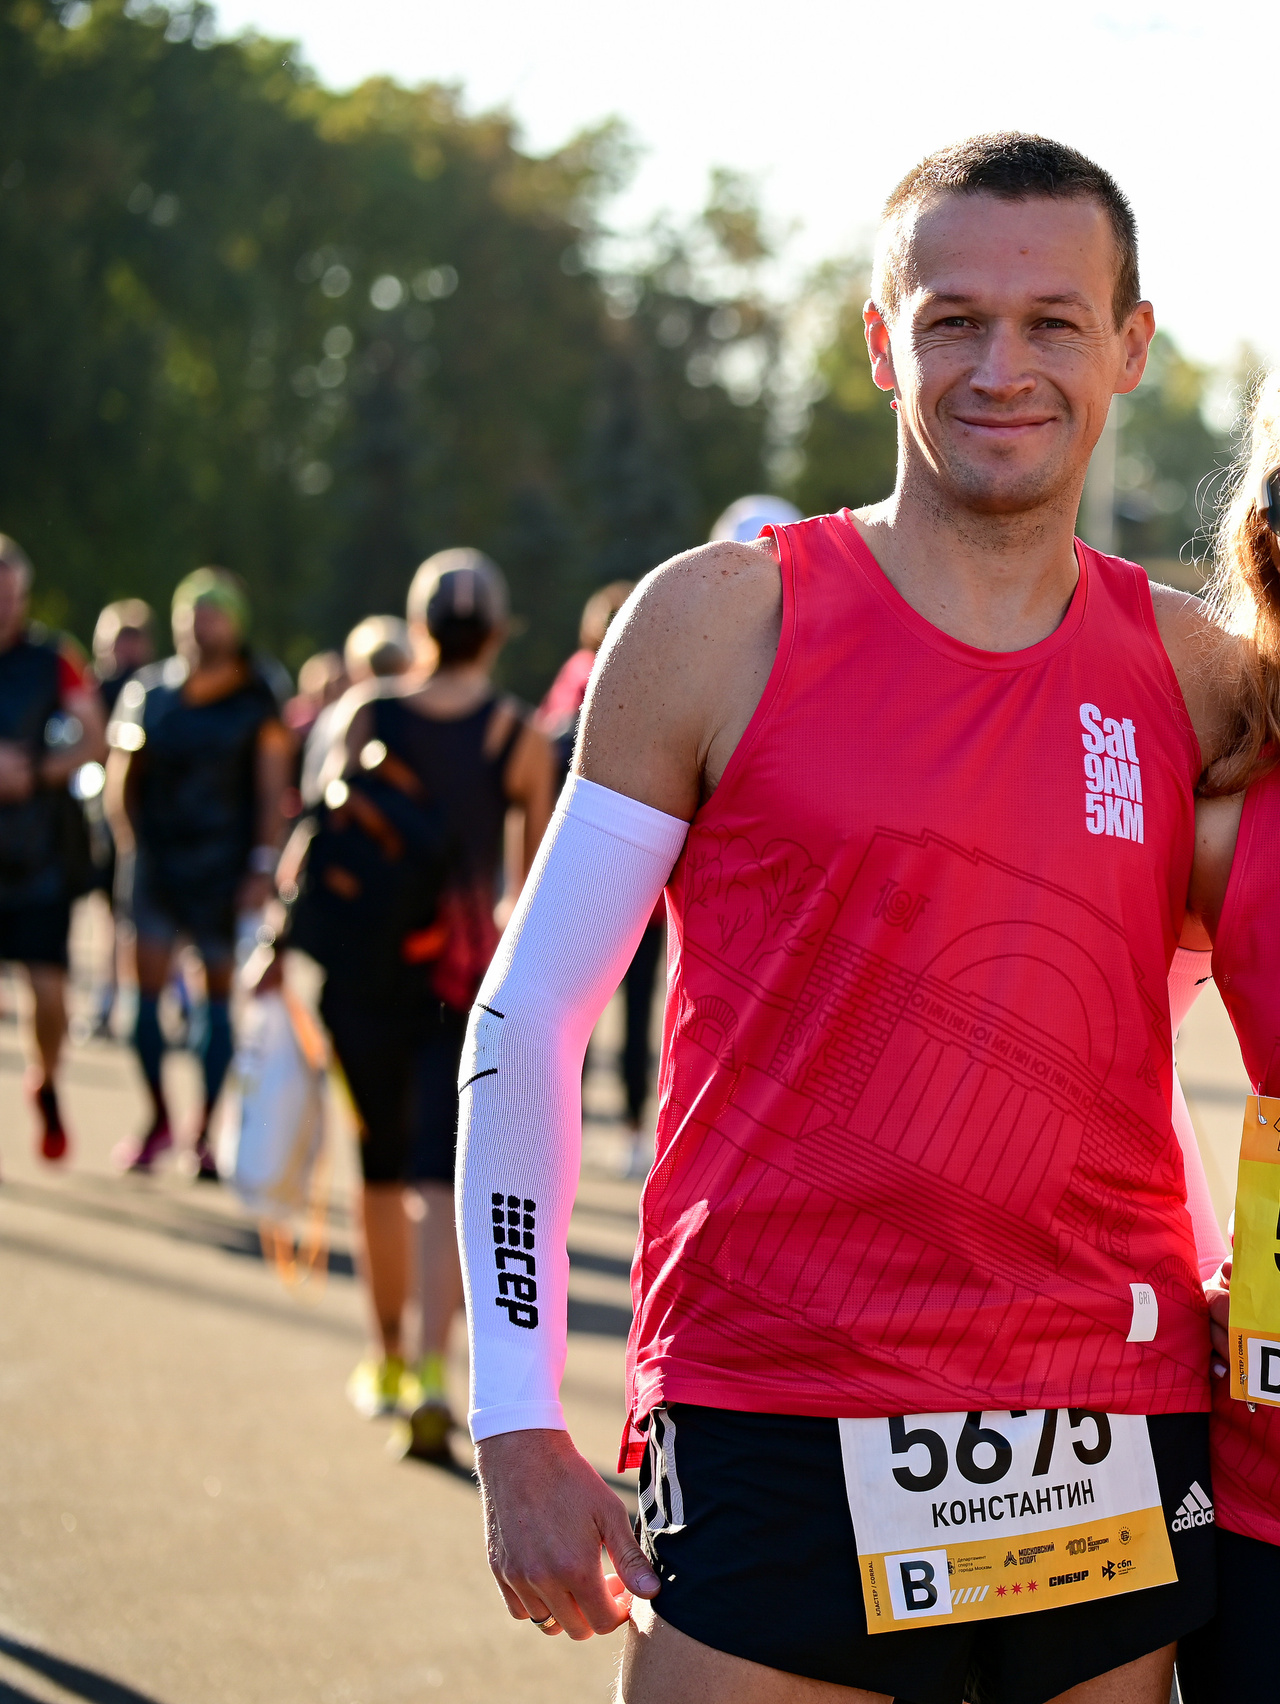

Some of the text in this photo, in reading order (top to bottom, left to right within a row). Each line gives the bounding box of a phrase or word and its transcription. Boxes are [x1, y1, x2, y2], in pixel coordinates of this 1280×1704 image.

[1079, 702, 1140, 764] Sat
[1084, 753, 1143, 804] 9AM
[1085, 793, 1144, 844] 5KM
[494, 1247, 539, 1330] cep
[888, 1408, 1112, 1492] 5675
[931, 1478, 1095, 1529] КОНСТАНТИН
[1018, 1541, 1055, 1557] МОСКОВСКИЙ
[1019, 1554, 1037, 1566] СПОРТ
[1065, 1537, 1087, 1556] 100
[868, 1560, 876, 1584] CORRAL
[1116, 1558, 1132, 1569] сбп
[1048, 1569, 1089, 1588] СИБУР
[872, 1589, 881, 1617] КЛАСТЕР
